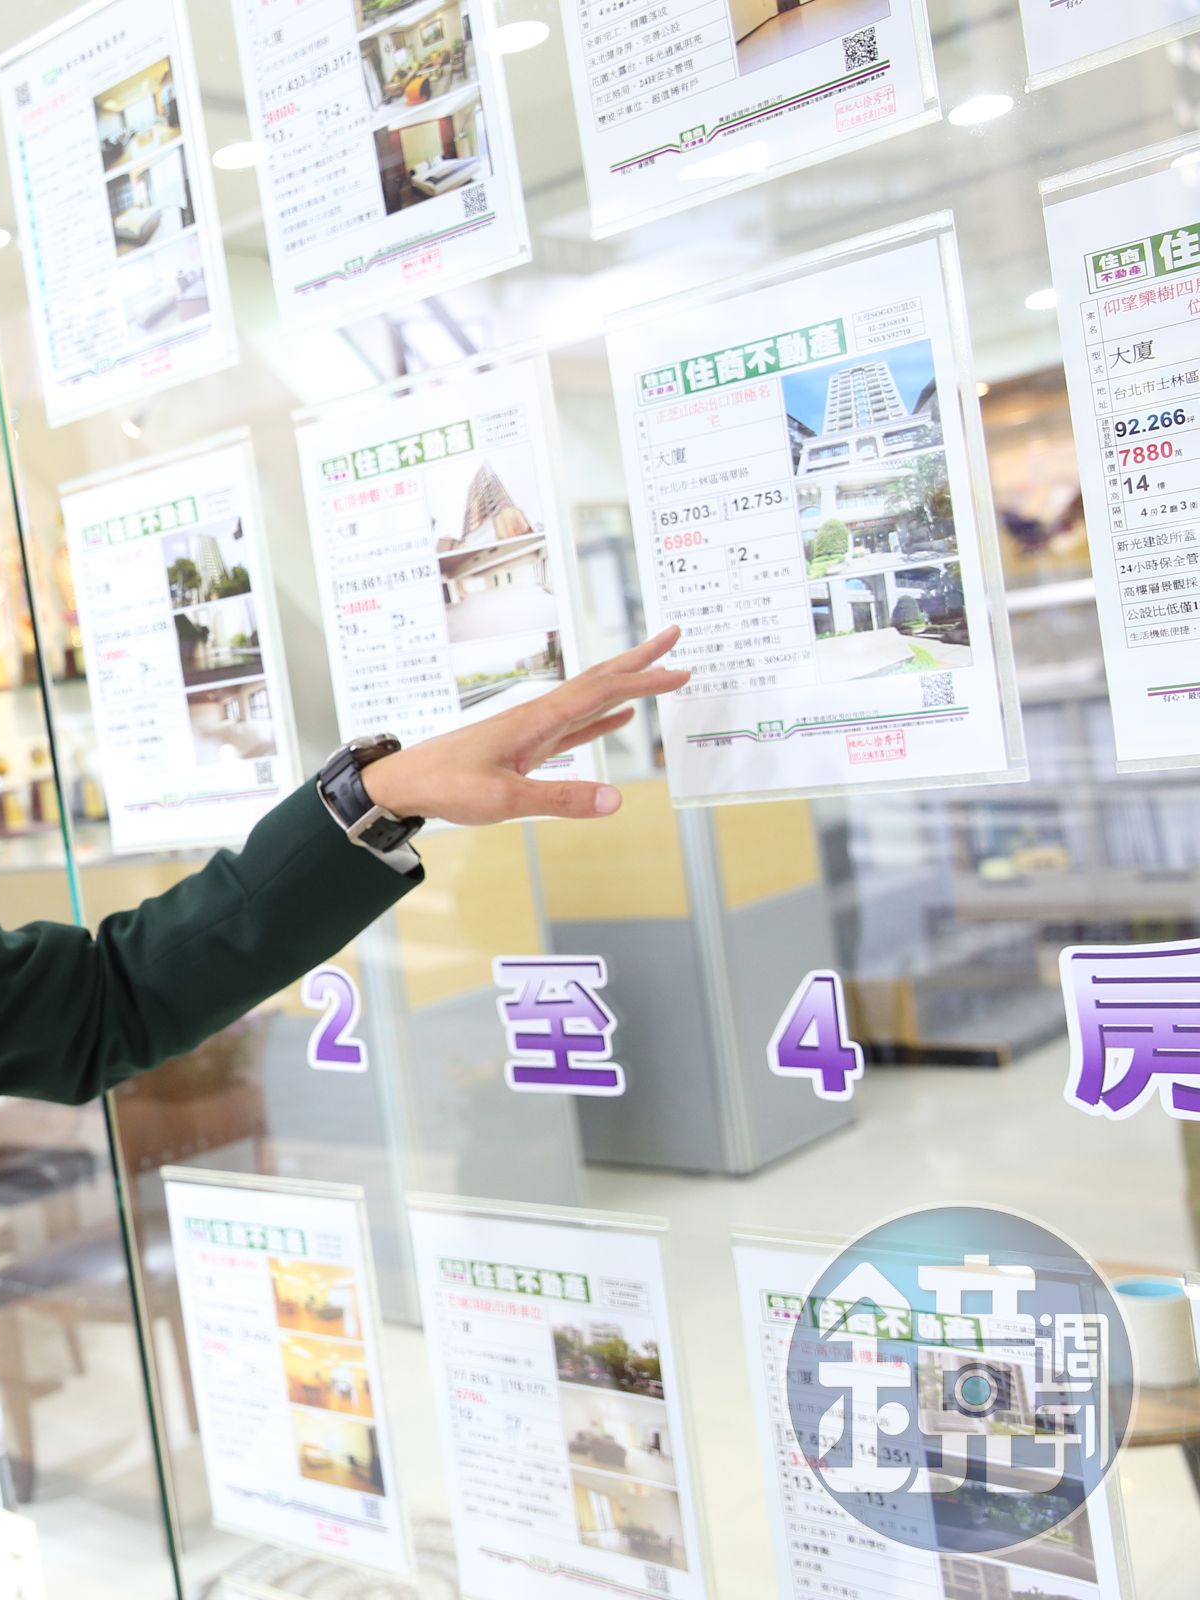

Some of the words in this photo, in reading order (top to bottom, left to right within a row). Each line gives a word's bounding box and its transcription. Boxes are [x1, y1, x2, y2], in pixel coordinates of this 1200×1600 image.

[1099, 248, 1140, 271] 住商
[1159, 230, 1200, 271] 住
[1100, 265, 1142, 283] 不動產
[1103, 278, 1200, 317] 仰望欒樹四
[685, 322, 842, 391] 住商不動產
[1109, 341, 1155, 369] 大廈
[1113, 369, 1200, 401] 台北市士林區
[1115, 409, 1186, 437] 92.266
[1118, 441, 1173, 467] 7880
[1123, 474, 1149, 494] 14
[732, 490, 783, 511] 12.753
[660, 505, 711, 526] 69.703
[663, 531, 702, 550] 6980
[1117, 529, 1197, 552] 新光建設所蓋
[738, 547, 748, 561] 2
[1120, 552, 1200, 575] 24小時保全管
[667, 558, 686, 574] 12
[1123, 576, 1200, 598] 高樓層景觀採
[1127, 601, 1200, 621] 公設比低僅1
[308, 970, 363, 1066] 2
[499, 960, 621, 1091] 至
[775, 974, 860, 1094] 4
[1068, 946, 1200, 1113] 房
